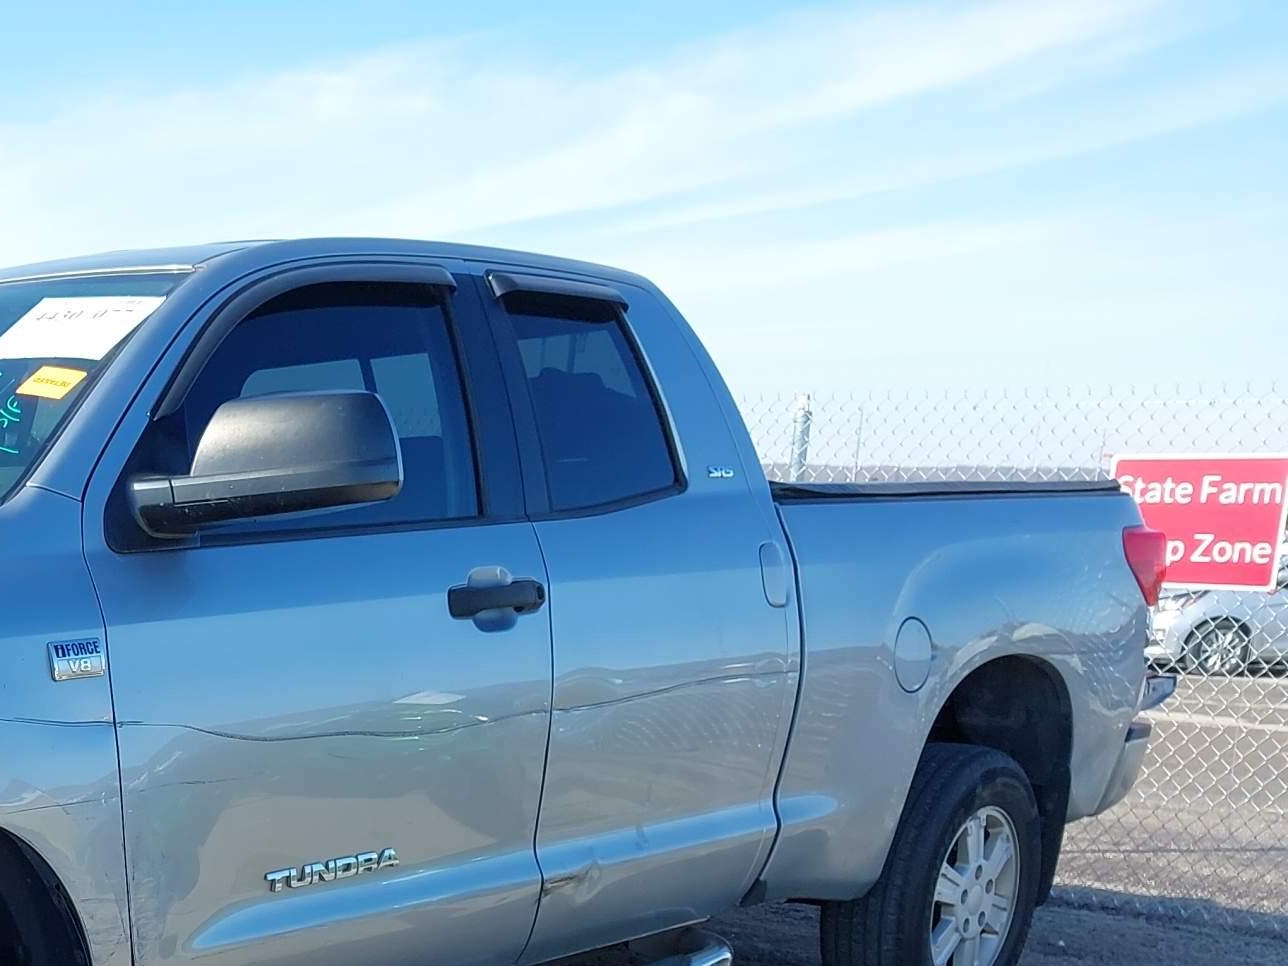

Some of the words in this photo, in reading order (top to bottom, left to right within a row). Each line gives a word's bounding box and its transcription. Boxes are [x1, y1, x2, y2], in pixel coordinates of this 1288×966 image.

[1116, 475, 1193, 504] State
[1200, 475, 1283, 504] Farm
[1189, 533, 1273, 564] Zone
[68, 659, 92, 672] V8
[265, 848, 400, 893] TUNDRA
